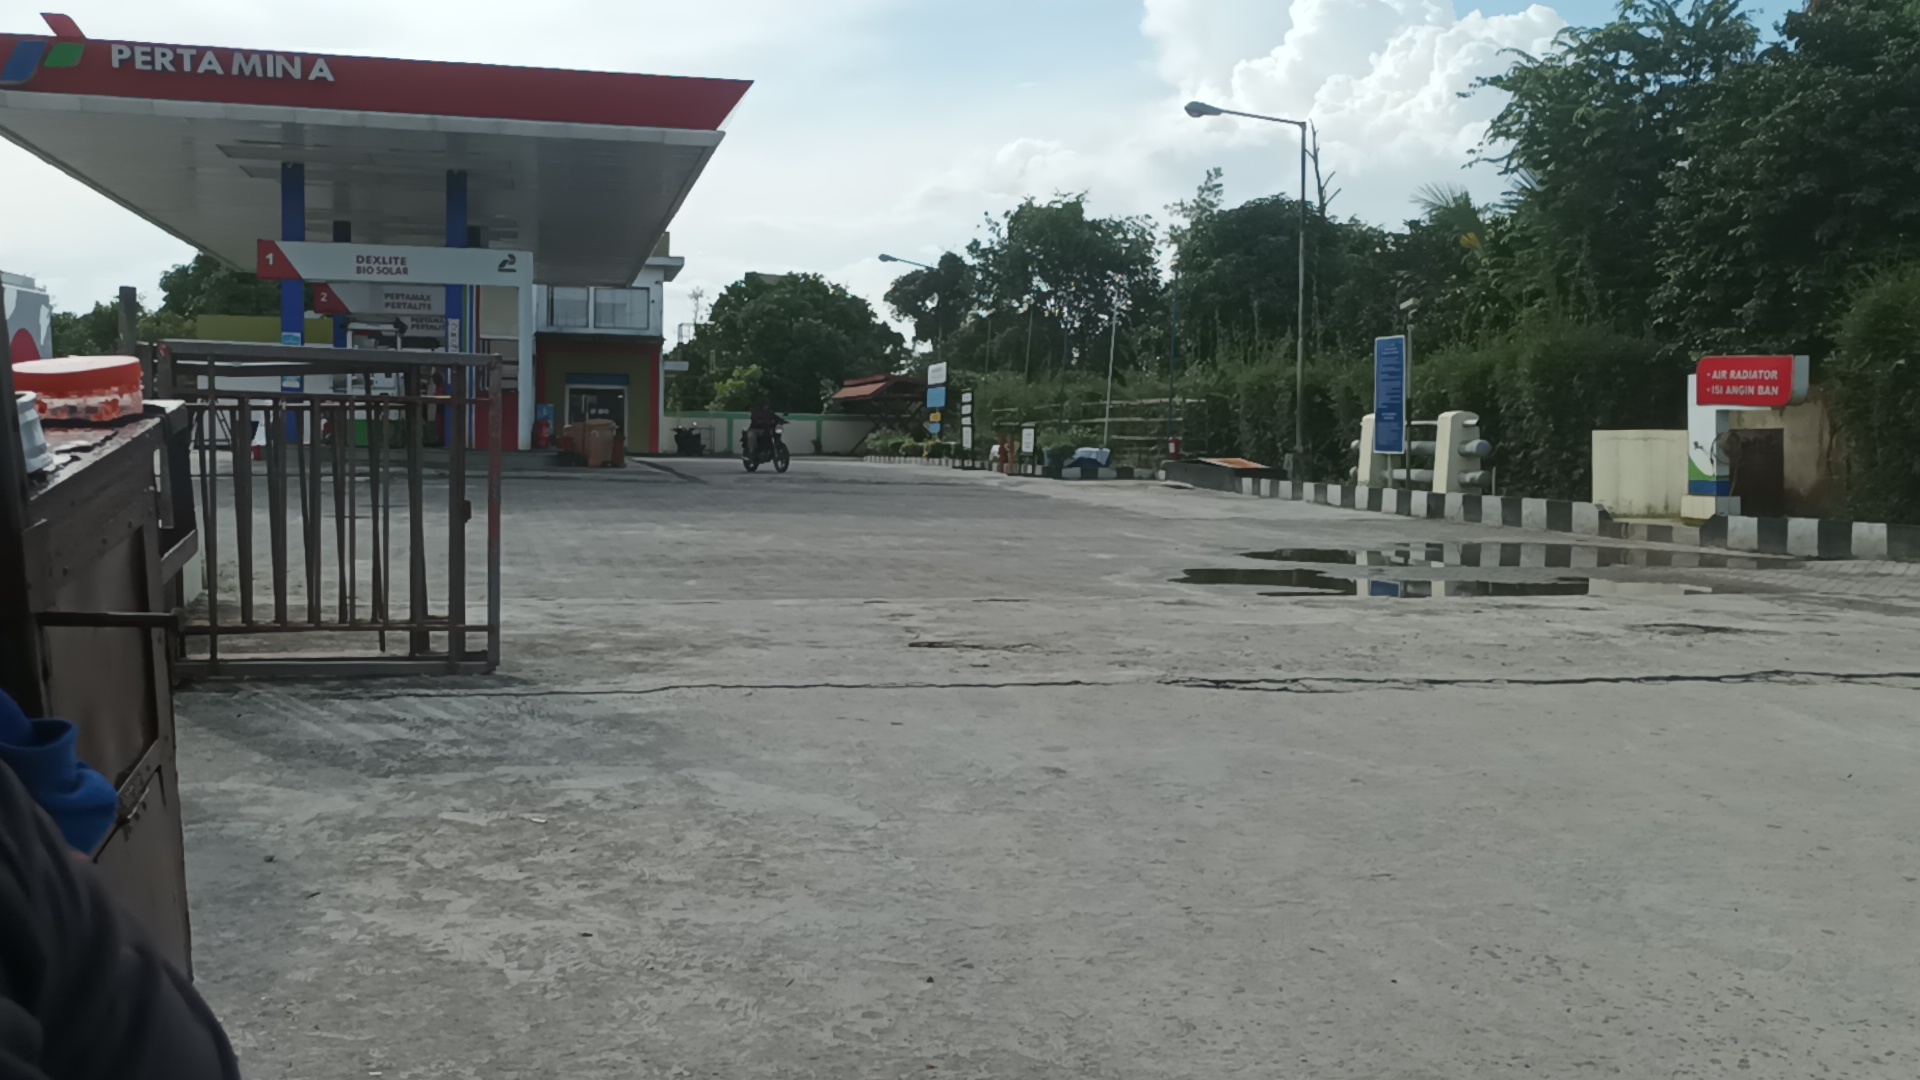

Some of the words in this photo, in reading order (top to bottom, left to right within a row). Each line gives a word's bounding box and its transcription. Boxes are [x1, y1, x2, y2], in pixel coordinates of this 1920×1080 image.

[111, 44, 335, 82] PERTAMINA
[265, 252, 274, 266] 1
[356, 255, 407, 266] DEXLITE
[356, 266, 374, 275] BIO
[376, 266, 409, 276] SOLAR
[320, 292, 328, 302] 2
[384, 292, 432, 302] PERTAMAX
[384, 302, 433, 311] PERTALITE
[1711, 370, 1727, 380] AIR
[1729, 370, 1778, 380] RADIATOR
[1711, 385, 1724, 395] ISI
[1725, 385, 1756, 396] ANGIN
[1757, 385, 1779, 396] BAN
